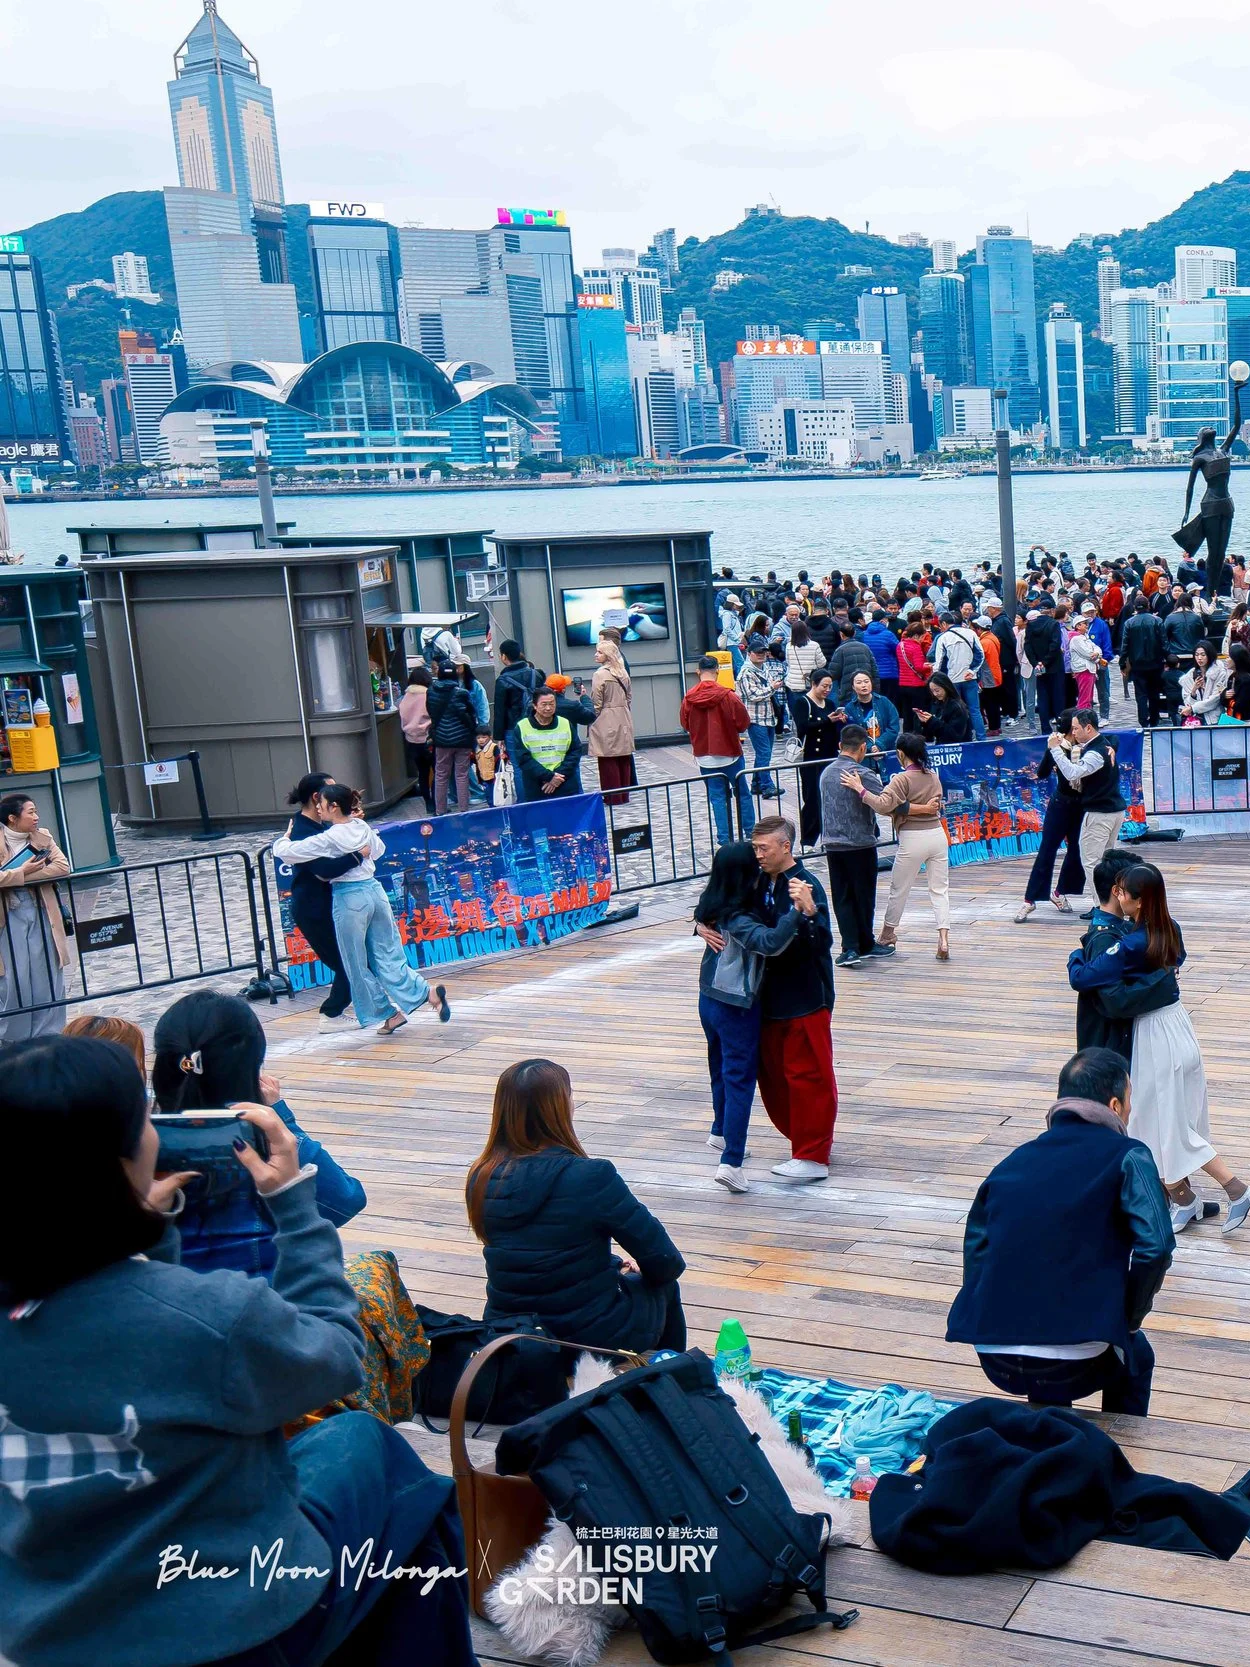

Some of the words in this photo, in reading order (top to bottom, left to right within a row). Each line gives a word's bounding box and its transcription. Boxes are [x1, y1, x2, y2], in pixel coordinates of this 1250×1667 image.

[328, 203, 366, 216] FWD
[0, 236, 18, 251] 行
[827, 342, 875, 354] 萬通保險
[941, 808, 1044, 846] 海邊舞
[992, 831, 1044, 858] MILON
[524, 893, 550, 920] 25
[551, 884, 589, 914] MAR
[592, 879, 612, 904] 30
[101, 922, 124, 932] AVENUE
[288, 960, 336, 992] BLU
[424, 924, 521, 967] MILONGA
[524, 919, 541, 946] X
